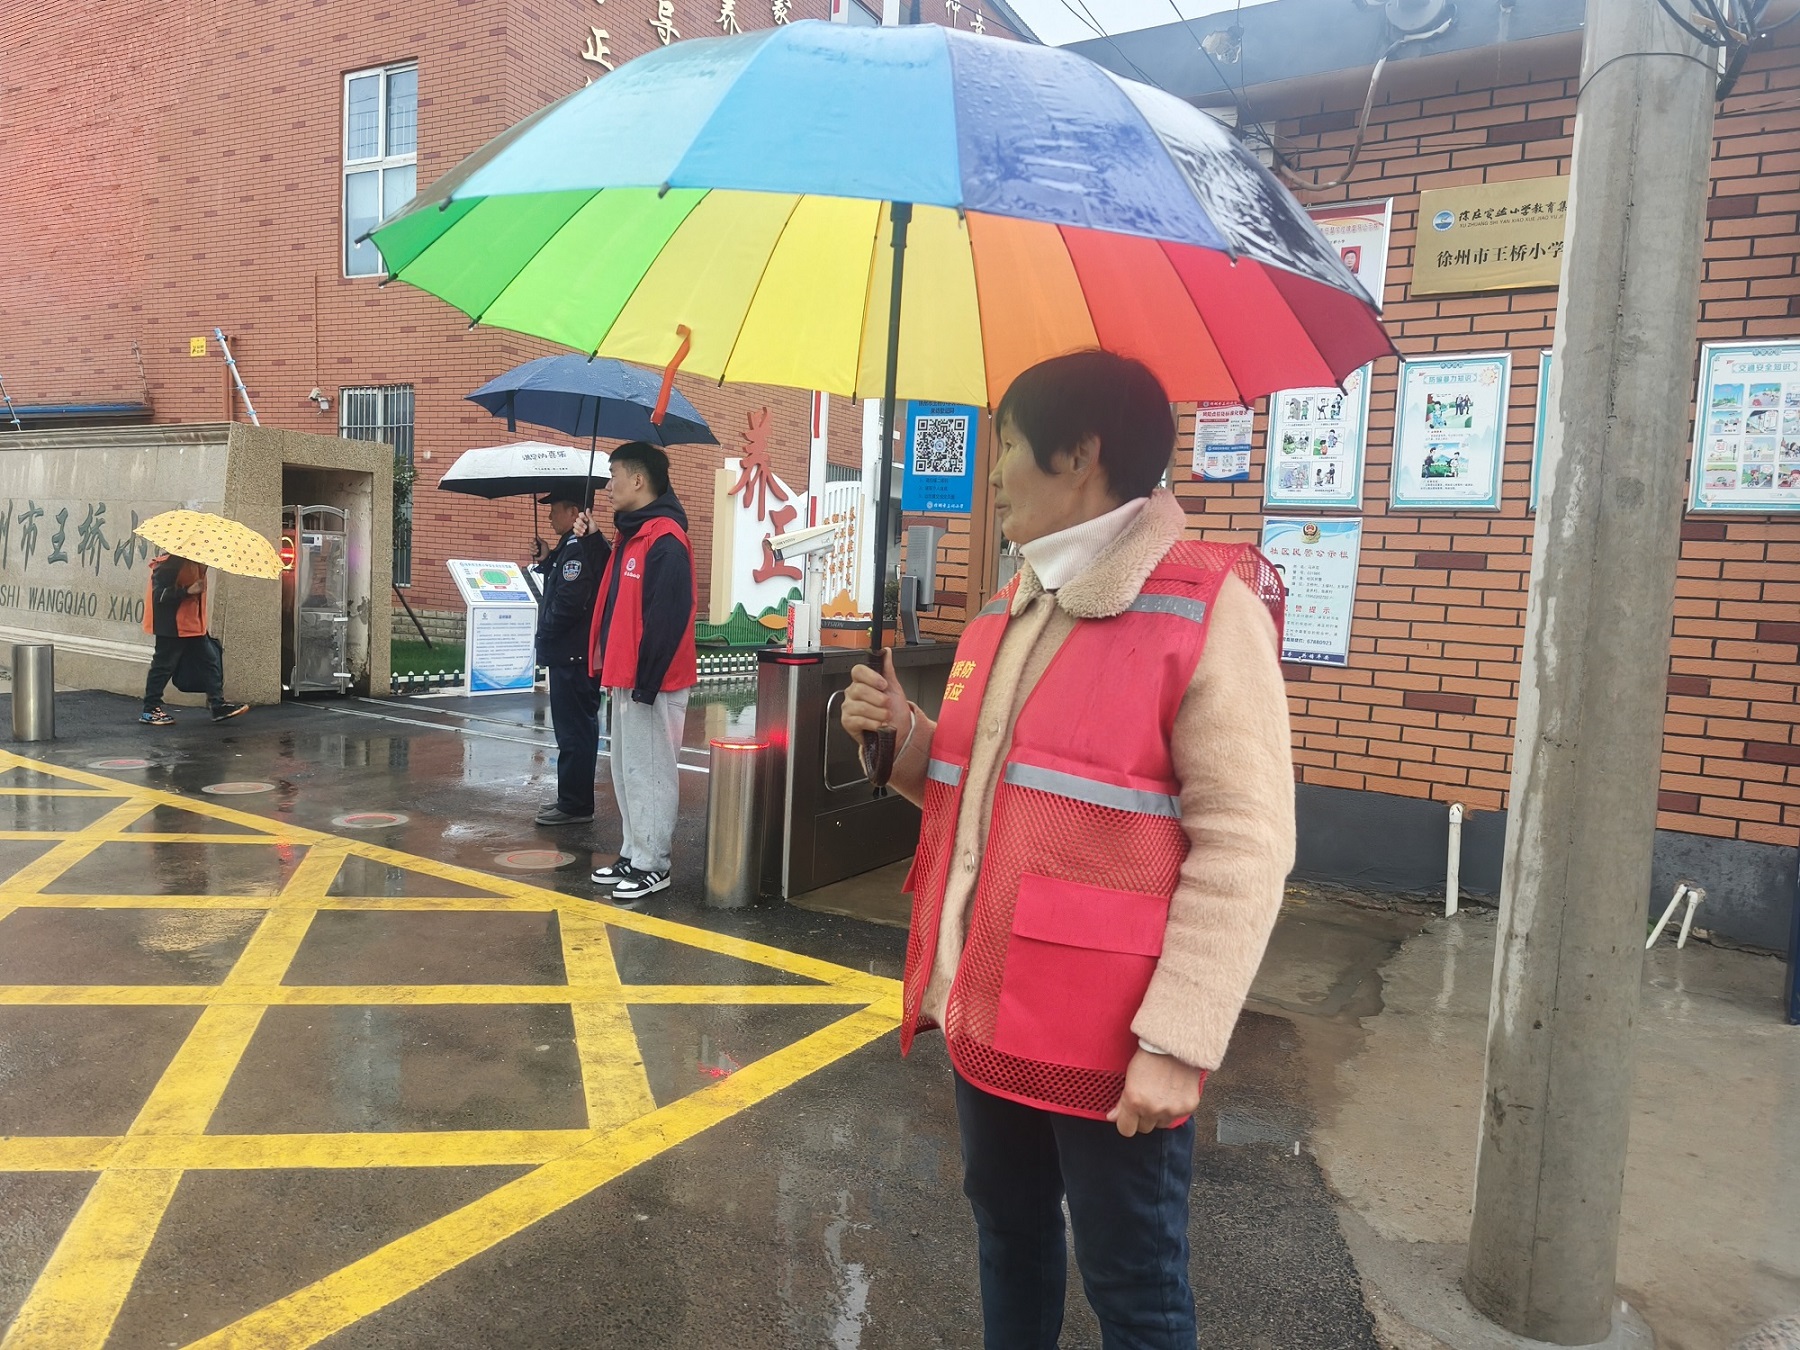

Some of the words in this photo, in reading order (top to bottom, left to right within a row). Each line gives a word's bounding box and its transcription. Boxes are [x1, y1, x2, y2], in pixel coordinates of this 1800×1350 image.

[1436, 241, 1564, 268] 徐州市王桥小学
[1269, 547, 1349, 559] 社区民警公示栏
[0, 585, 20, 608] SHI
[29, 587, 98, 617] WANGQIAO
[108, 595, 145, 624] XIAO
